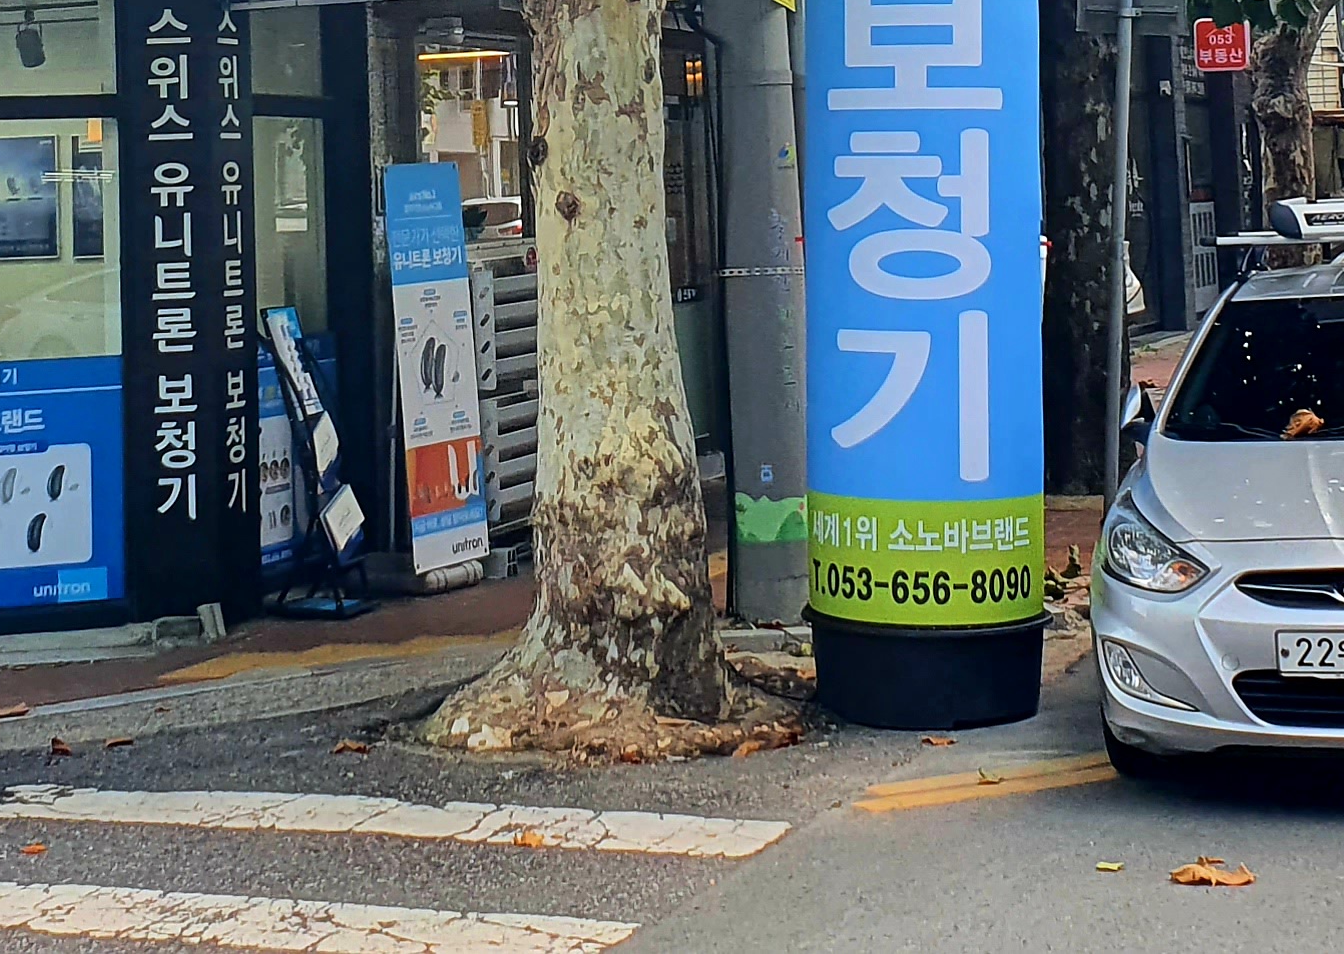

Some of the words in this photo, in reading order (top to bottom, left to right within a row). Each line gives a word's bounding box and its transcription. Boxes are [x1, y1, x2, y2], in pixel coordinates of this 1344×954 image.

[146, 8, 194, 141] 스위스
[216, 9, 242, 140] 스위스
[1199, 48, 1244, 64] 부동산
[1208, 34, 1233, 45] 053
[150, 161, 197, 354] 유니트론
[220, 160, 246, 350] 유니트론
[393, 247, 432, 270] 유니트론
[432, 244, 462, 265] 보청기
[154, 373, 198, 521] 보청기
[225, 369, 247, 514] 보청기
[33, 579, 91, 598] unitron
[452, 537, 484, 555] unitron
[812, 557, 1032, 605] T.053-656-8090
